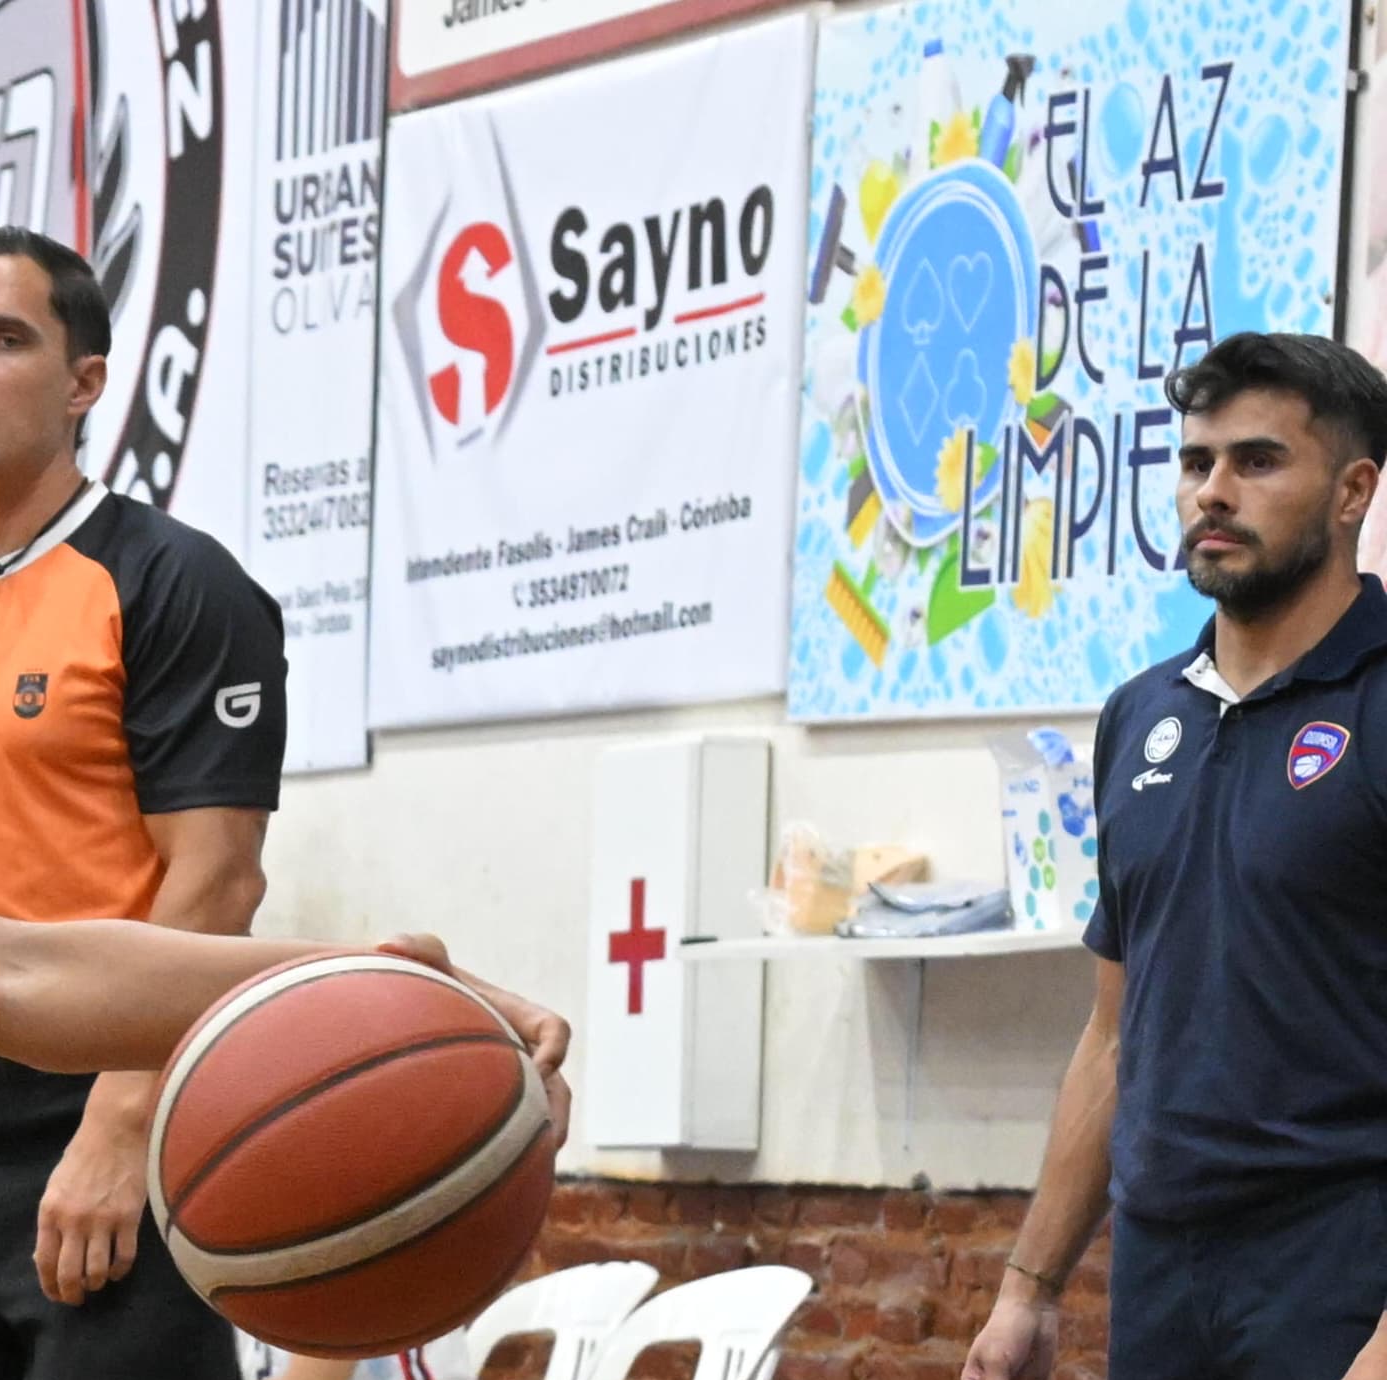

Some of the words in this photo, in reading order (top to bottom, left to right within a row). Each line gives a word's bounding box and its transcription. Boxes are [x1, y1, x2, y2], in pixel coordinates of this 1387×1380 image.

[1045, 88, 1104, 218] EL
[1139, 62, 1234, 208] AZ
[549, 184, 774, 332] Sayno
[1035, 255, 1108, 391] DE
[1138, 242, 1216, 380] LA
[550, 316, 767, 397] DISTRIBUCIONES
[498, 530, 553, 568] Fasolis
[566, 522, 621, 556] James
[627, 507, 668, 544] Craik
[679, 494, 752, 533] Córdoba
[960, 407, 1187, 588] LIMPIE
